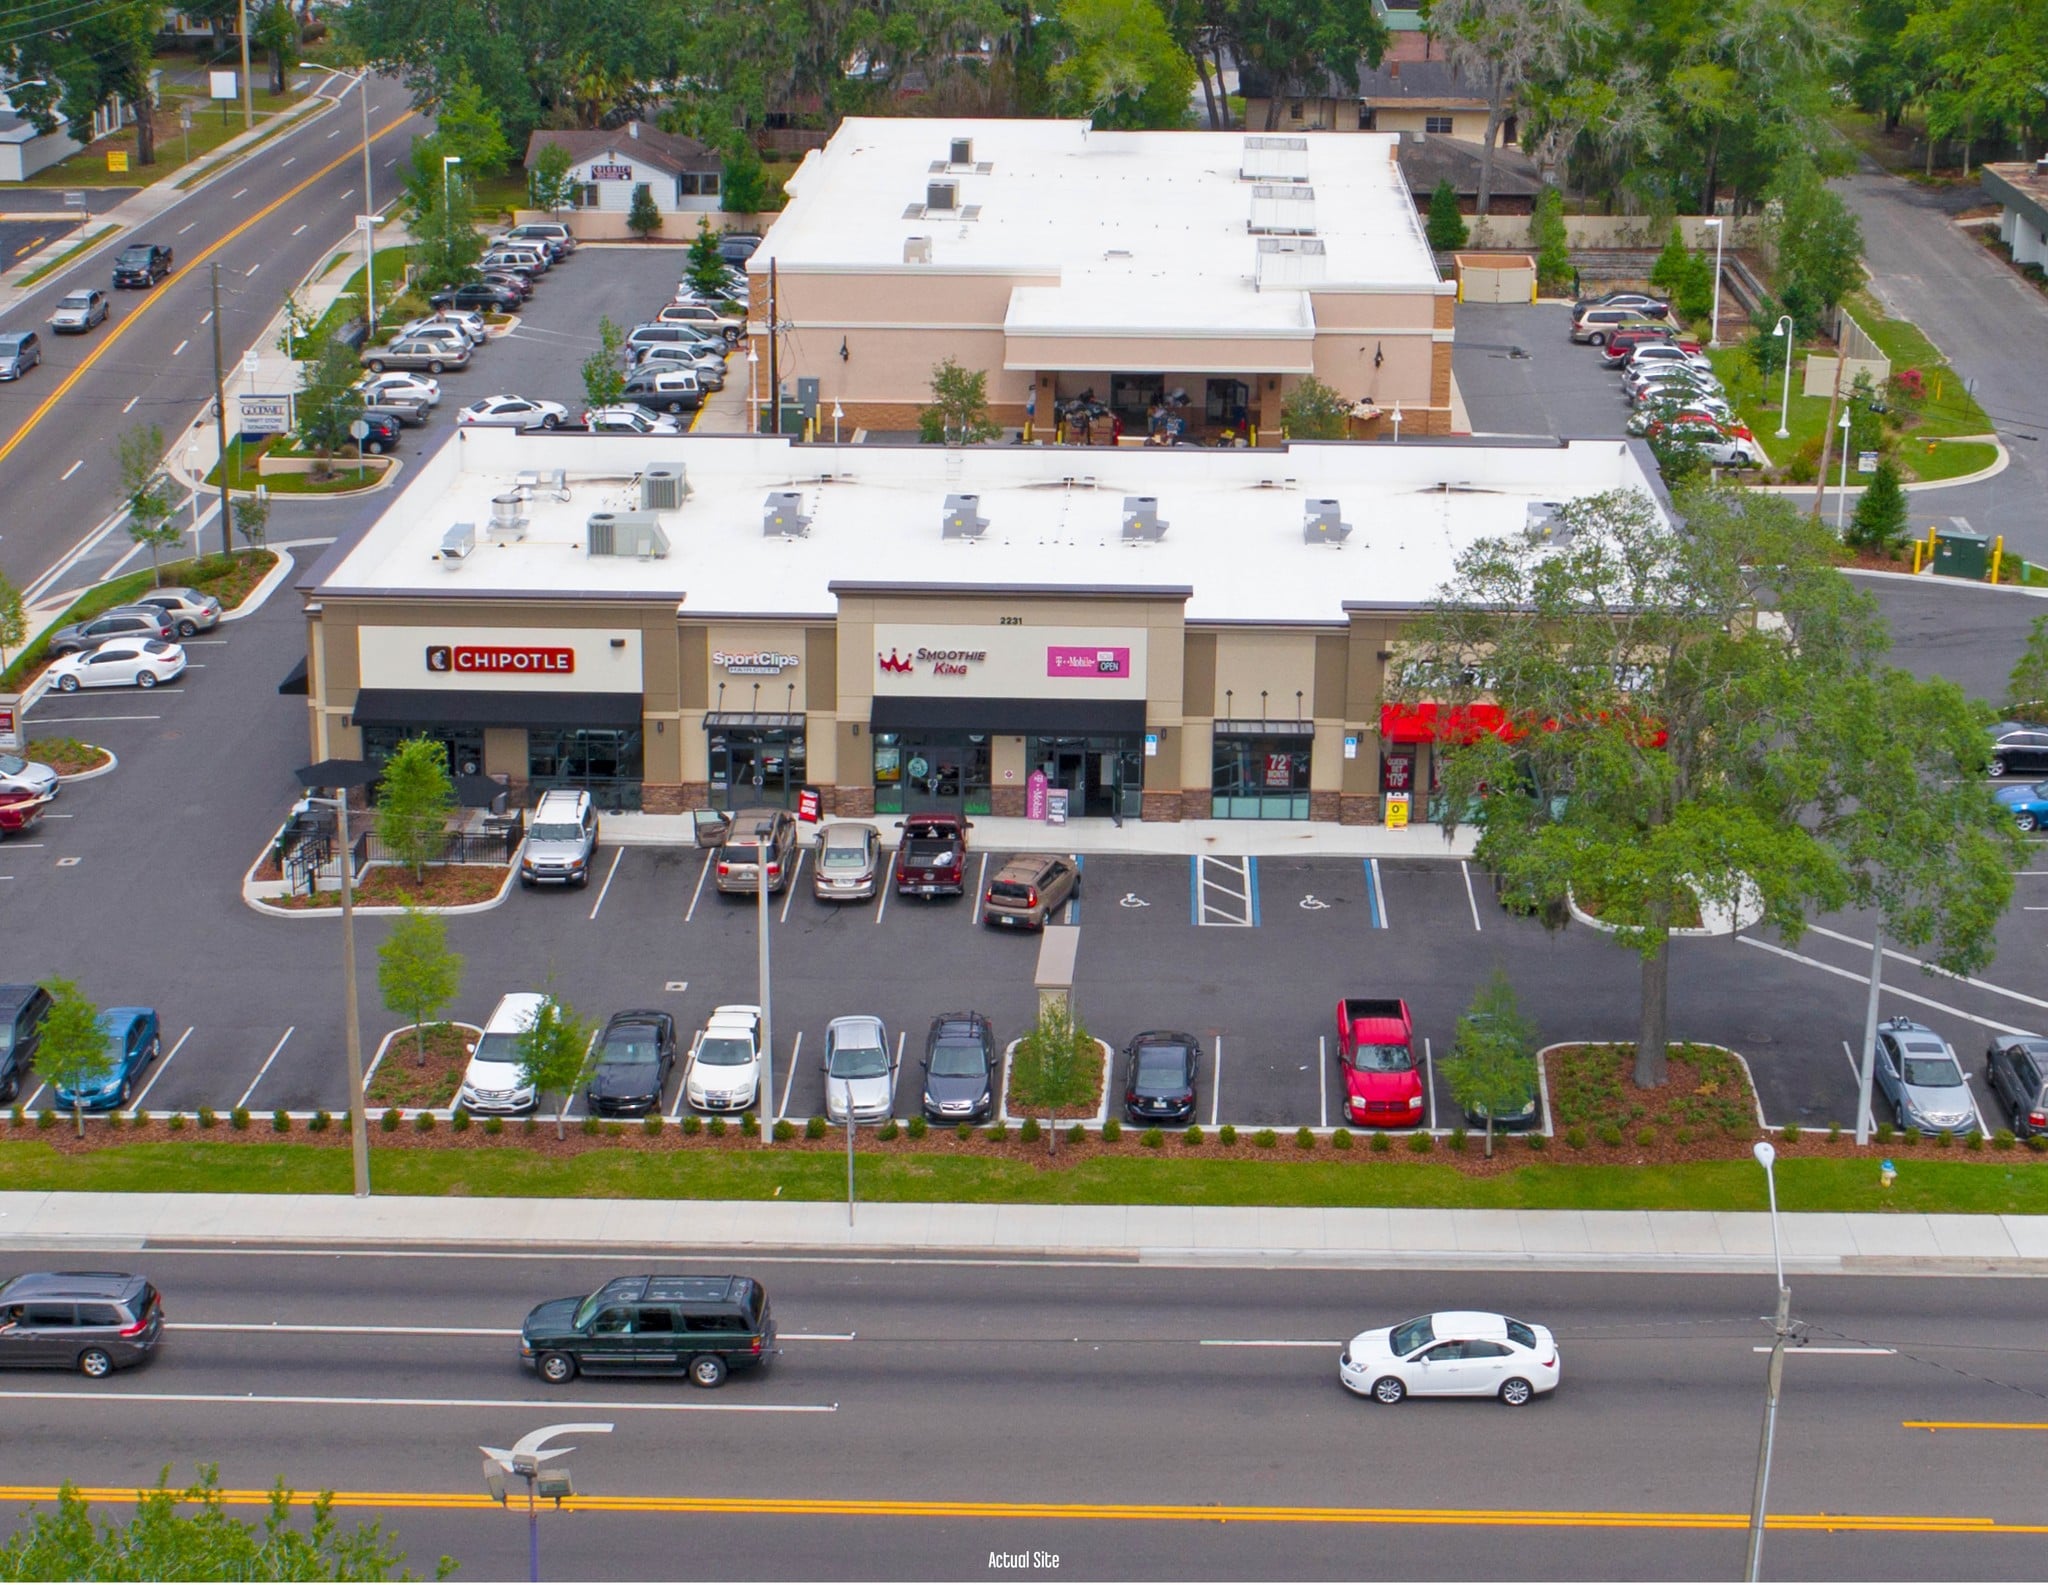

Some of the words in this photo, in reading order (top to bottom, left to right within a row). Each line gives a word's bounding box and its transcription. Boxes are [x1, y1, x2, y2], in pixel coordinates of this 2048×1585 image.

[1000, 616, 1022, 625] 2231
[458, 652, 569, 669] CHIPOTLE
[917, 648, 986, 661] SMOOTHIE
[1100, 661, 1119, 672] OPEN
